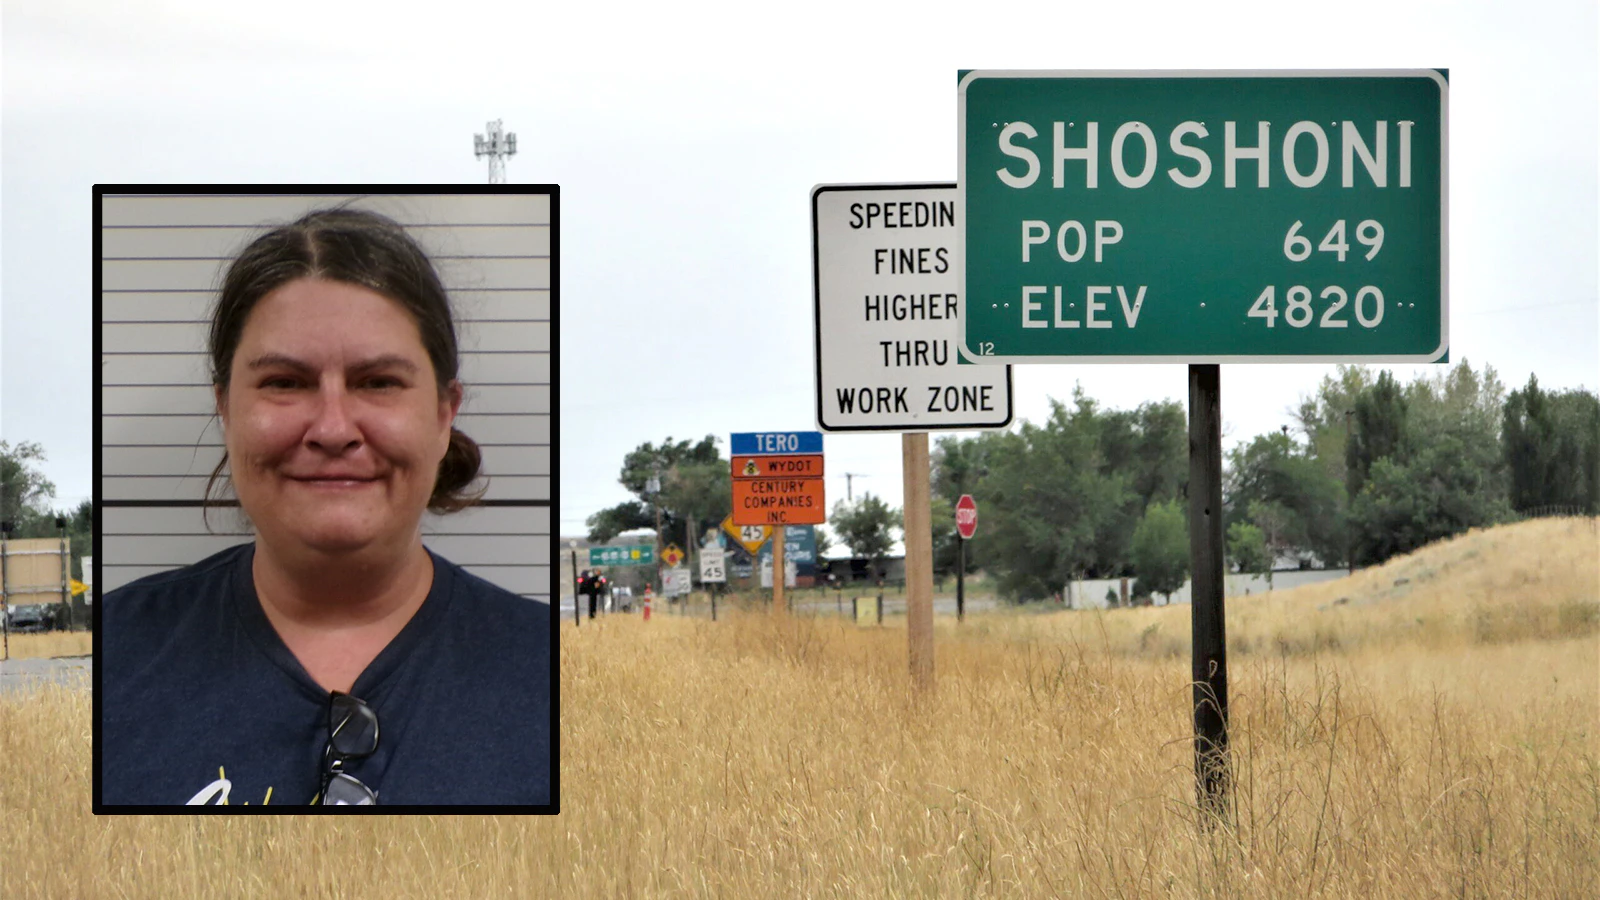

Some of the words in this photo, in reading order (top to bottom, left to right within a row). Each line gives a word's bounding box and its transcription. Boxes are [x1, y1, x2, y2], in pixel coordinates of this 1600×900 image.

[995, 120, 1412, 189] SHOSHONI
[849, 201, 955, 229] SPEEDIN
[1021, 219, 1124, 263] POP
[1283, 219, 1385, 262] 649
[874, 247, 949, 275] FINES
[864, 293, 958, 321] HIGHER
[1021, 285, 1148, 329] ELEV
[1247, 285, 1385, 329] 4820
[879, 339, 948, 367] THRU
[979, 342, 995, 356] 12
[836, 387, 909, 414] WORK
[927, 385, 994, 412] ZONE
[755, 433, 799, 452] TERO
[768, 460, 812, 472] WYDOT
[751, 480, 805, 493] CENTURY
[744, 495, 813, 509] COMPANIES
[957, 508, 977, 524] STOP
[742, 525, 763, 540] 45
[703, 567, 724, 578] 45
